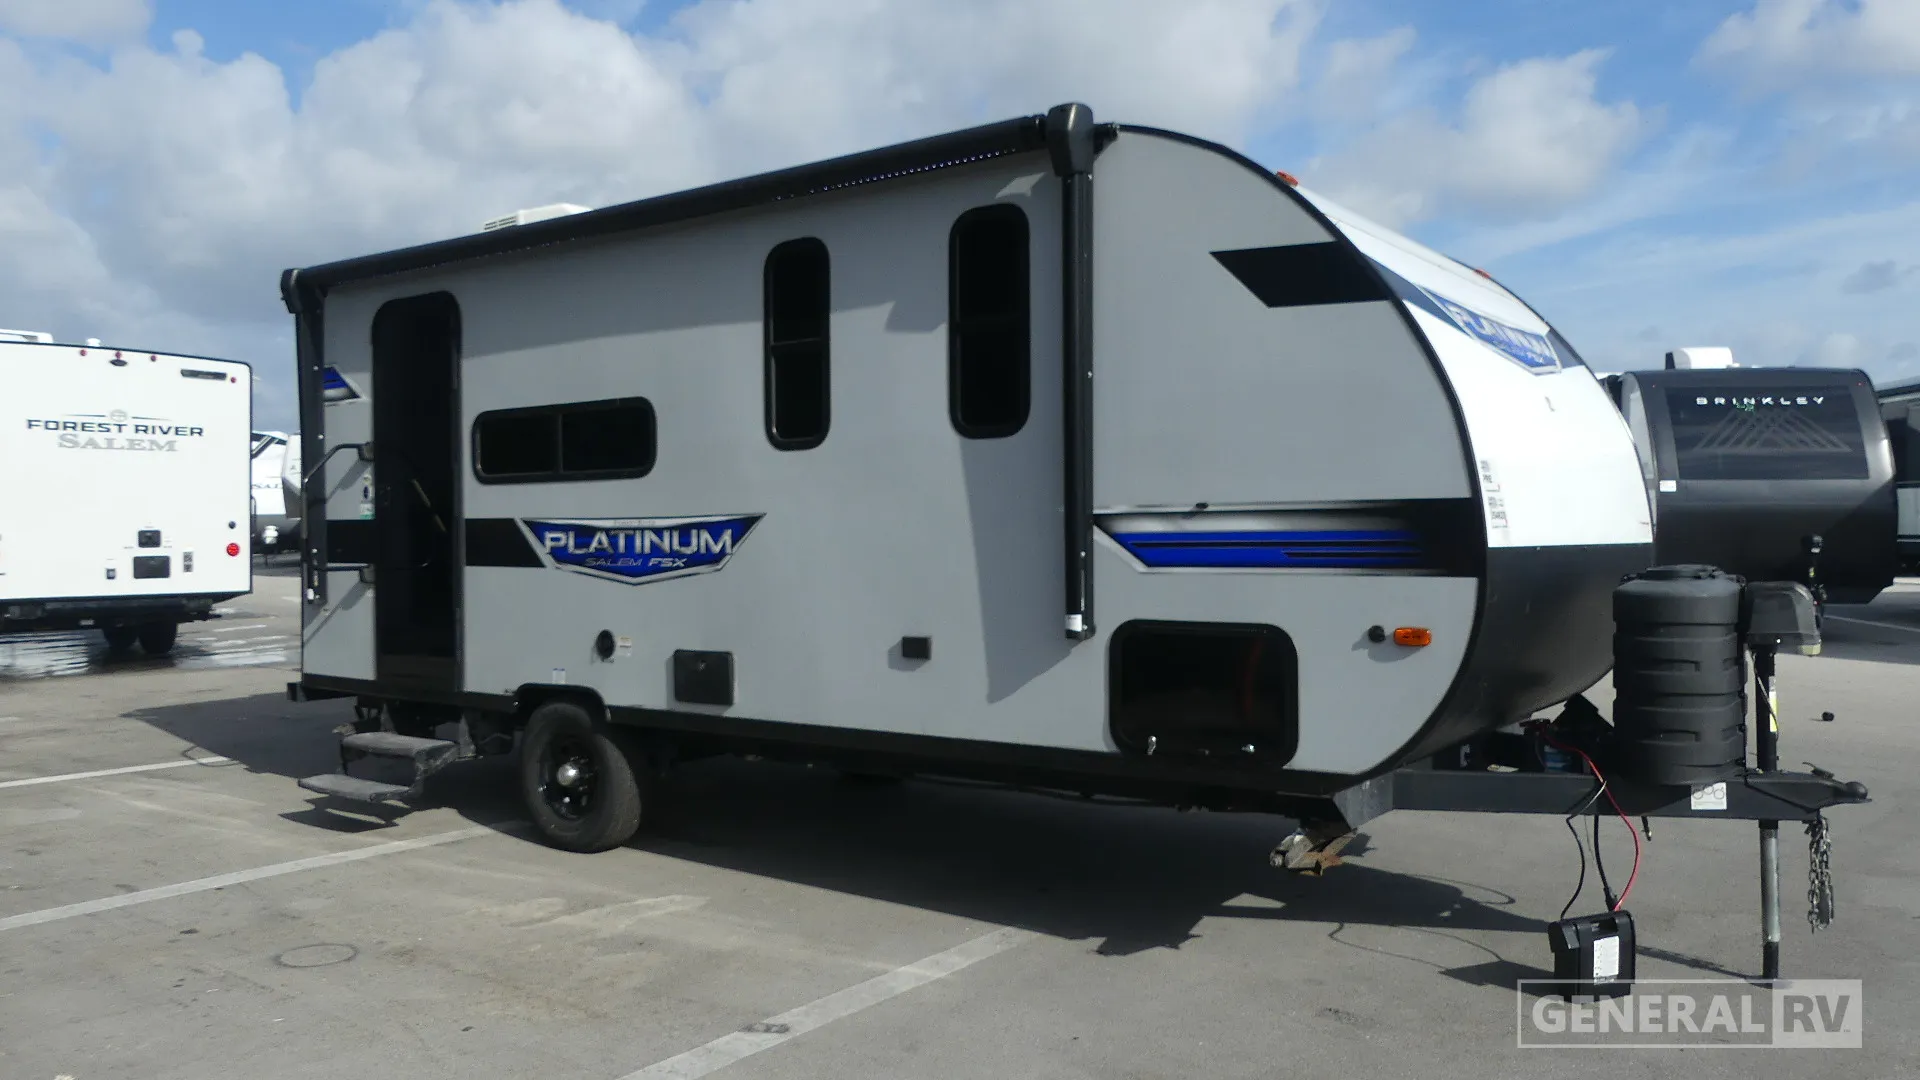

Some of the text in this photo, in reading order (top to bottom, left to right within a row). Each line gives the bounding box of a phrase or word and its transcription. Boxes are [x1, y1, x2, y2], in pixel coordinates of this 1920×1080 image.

[1696, 396, 1824, 406] BRINKLEY
[27, 419, 204, 438] FOREST RIVER
[57, 433, 178, 452] SALEM
[543, 528, 733, 555] PLATINUM
[584, 558, 687, 567] SALEM FSX
